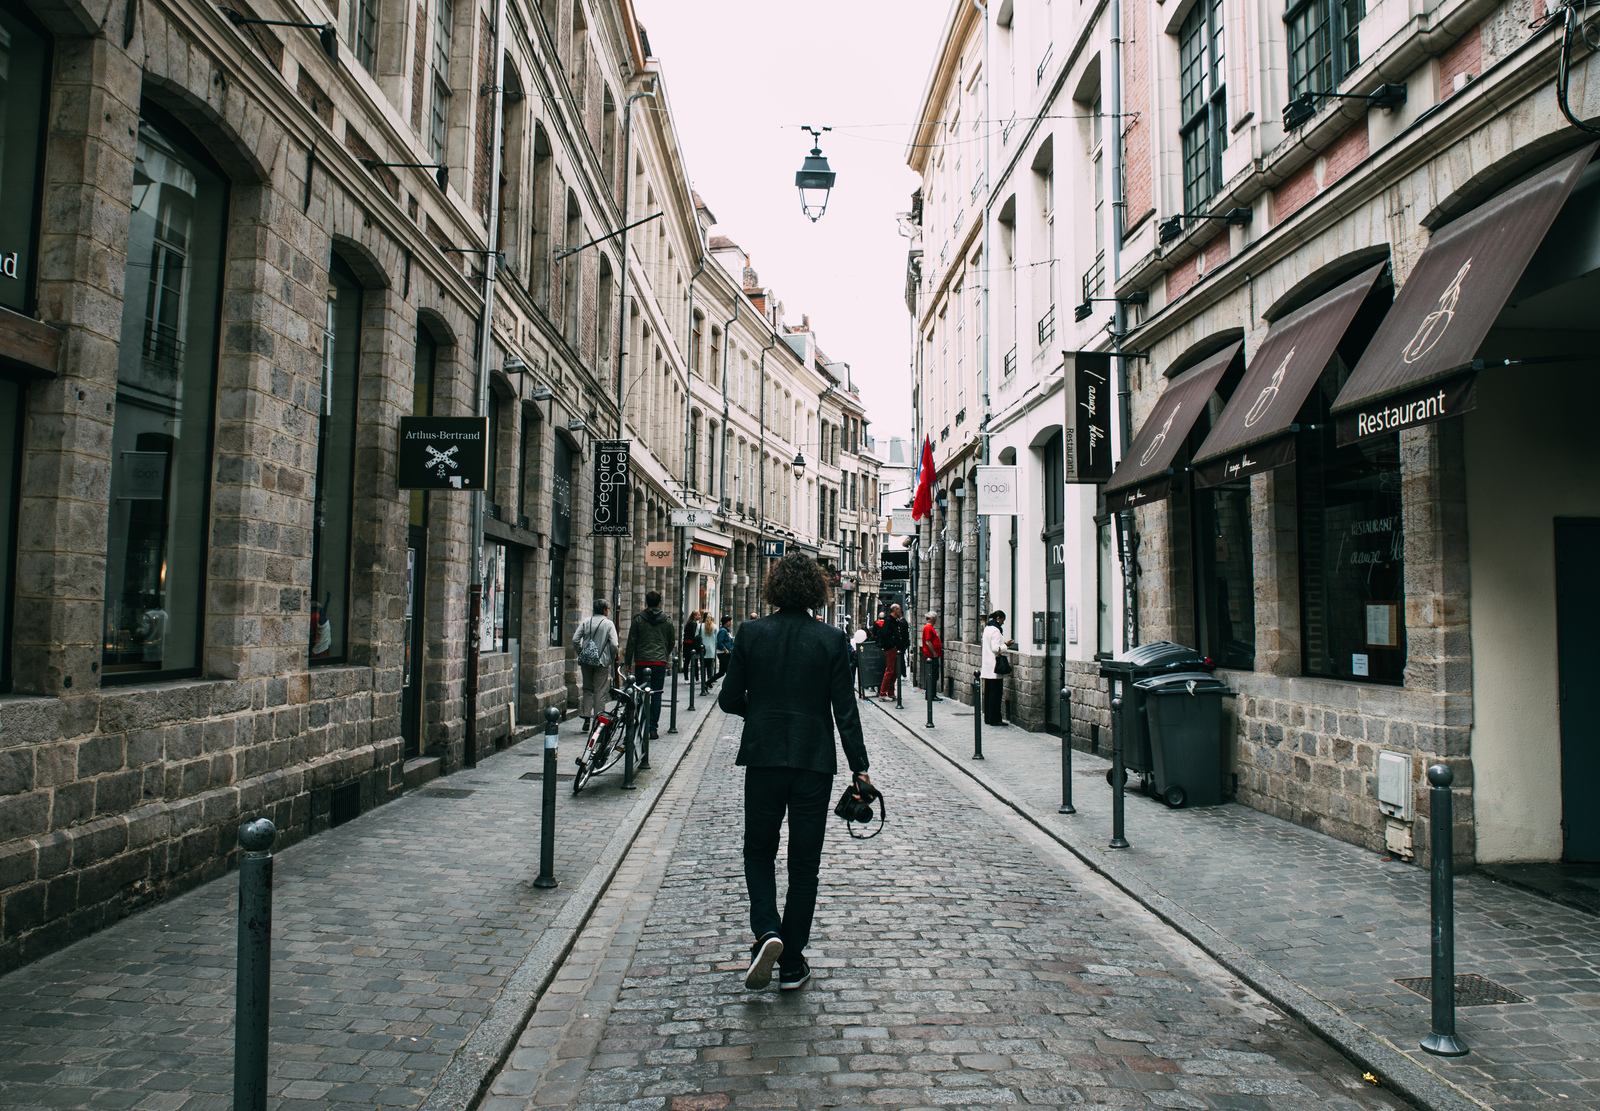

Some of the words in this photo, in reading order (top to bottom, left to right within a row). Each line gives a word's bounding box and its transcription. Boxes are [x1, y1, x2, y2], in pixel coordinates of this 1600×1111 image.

[1358, 389, 1446, 437] Restaurant
[1066, 428, 1074, 476] Restaurant
[594, 453, 614, 523] Grégoire
[594, 523, 627, 532] Création
[650, 550, 671, 559] sugar
